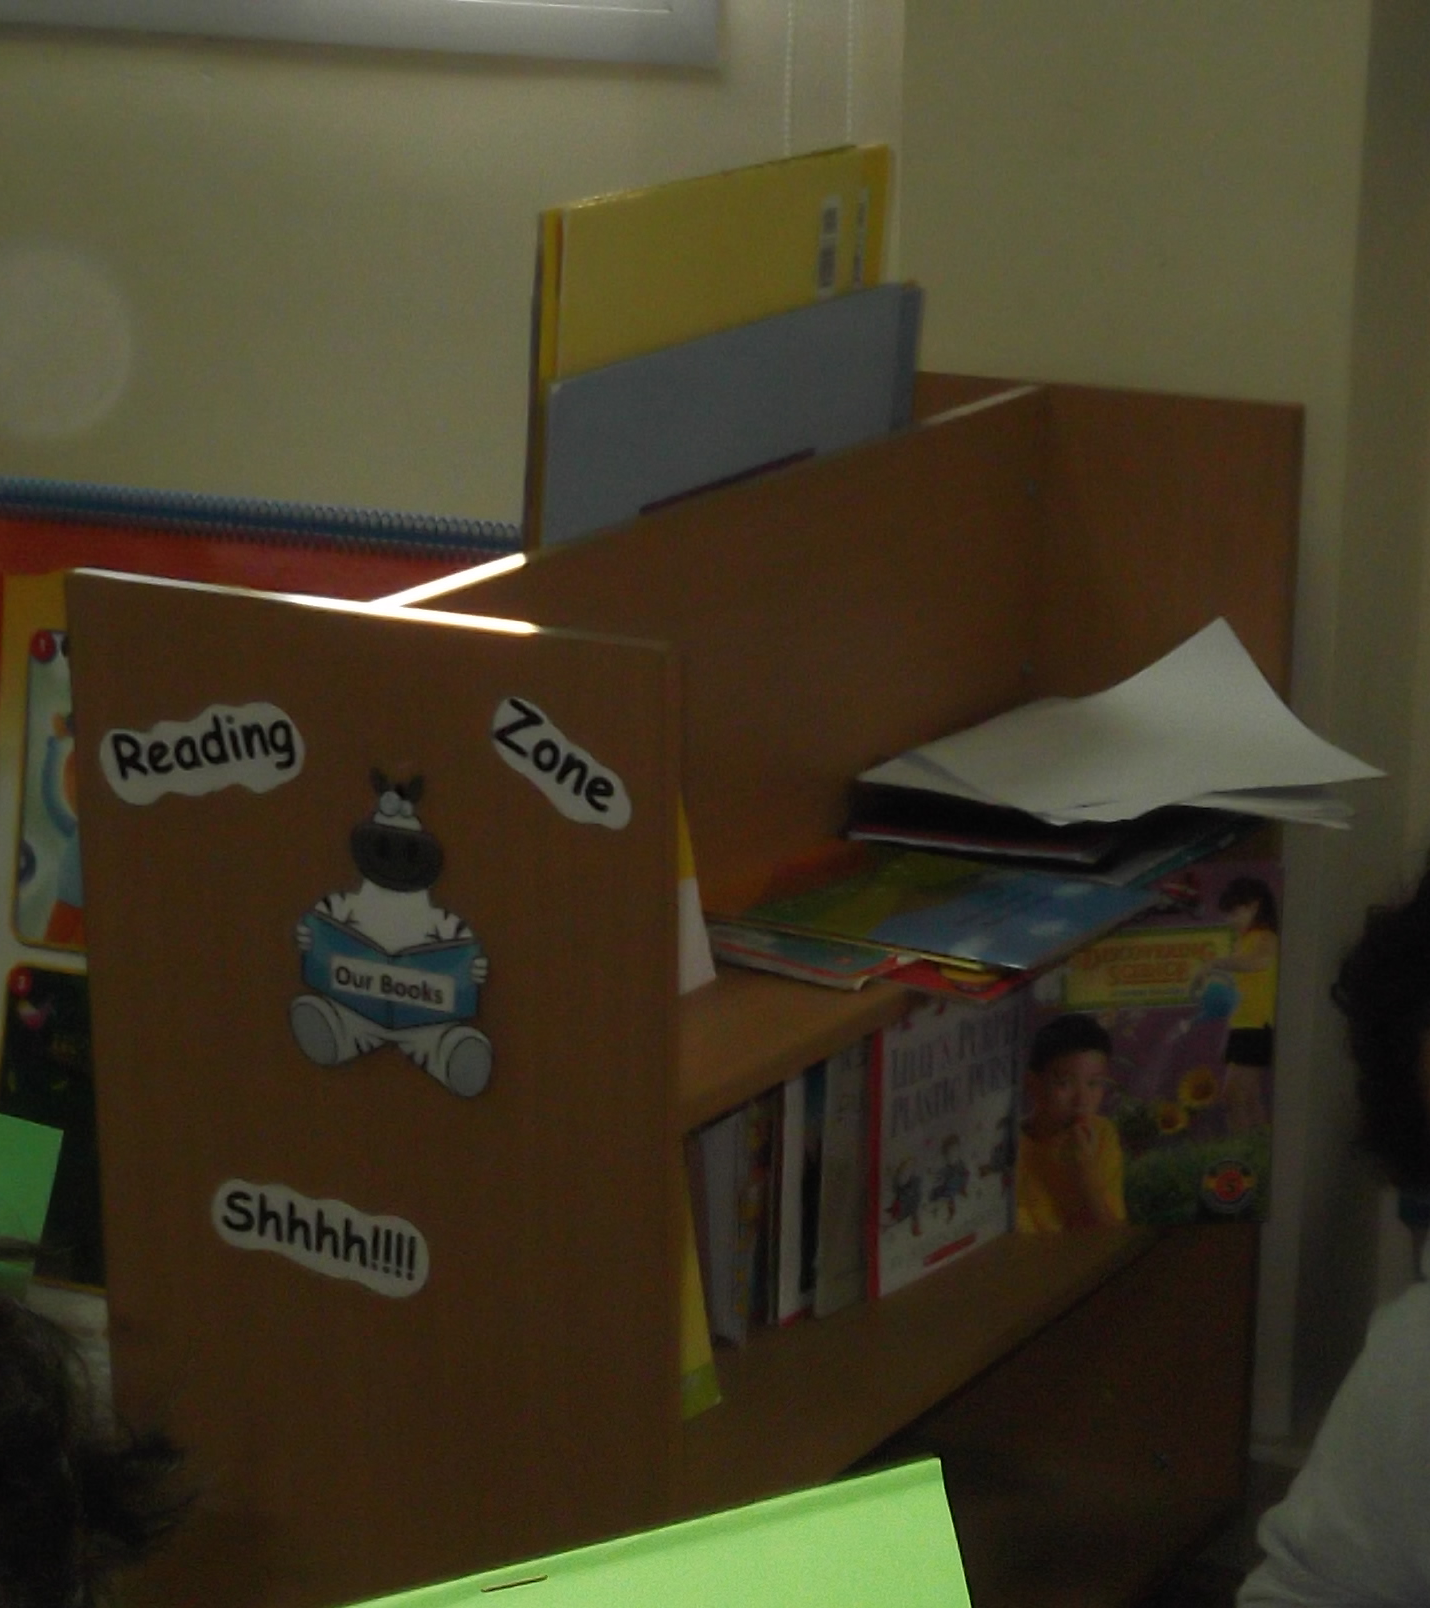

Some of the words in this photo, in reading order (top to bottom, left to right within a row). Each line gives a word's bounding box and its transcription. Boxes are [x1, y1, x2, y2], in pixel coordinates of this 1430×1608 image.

[112, 716, 297, 780] Reading
[492, 697, 617, 813] Zone
[334, 964, 373, 992] Our
[379, 971, 445, 1006] Books
[222, 1190, 418, 1281] Shhhh!!!!
